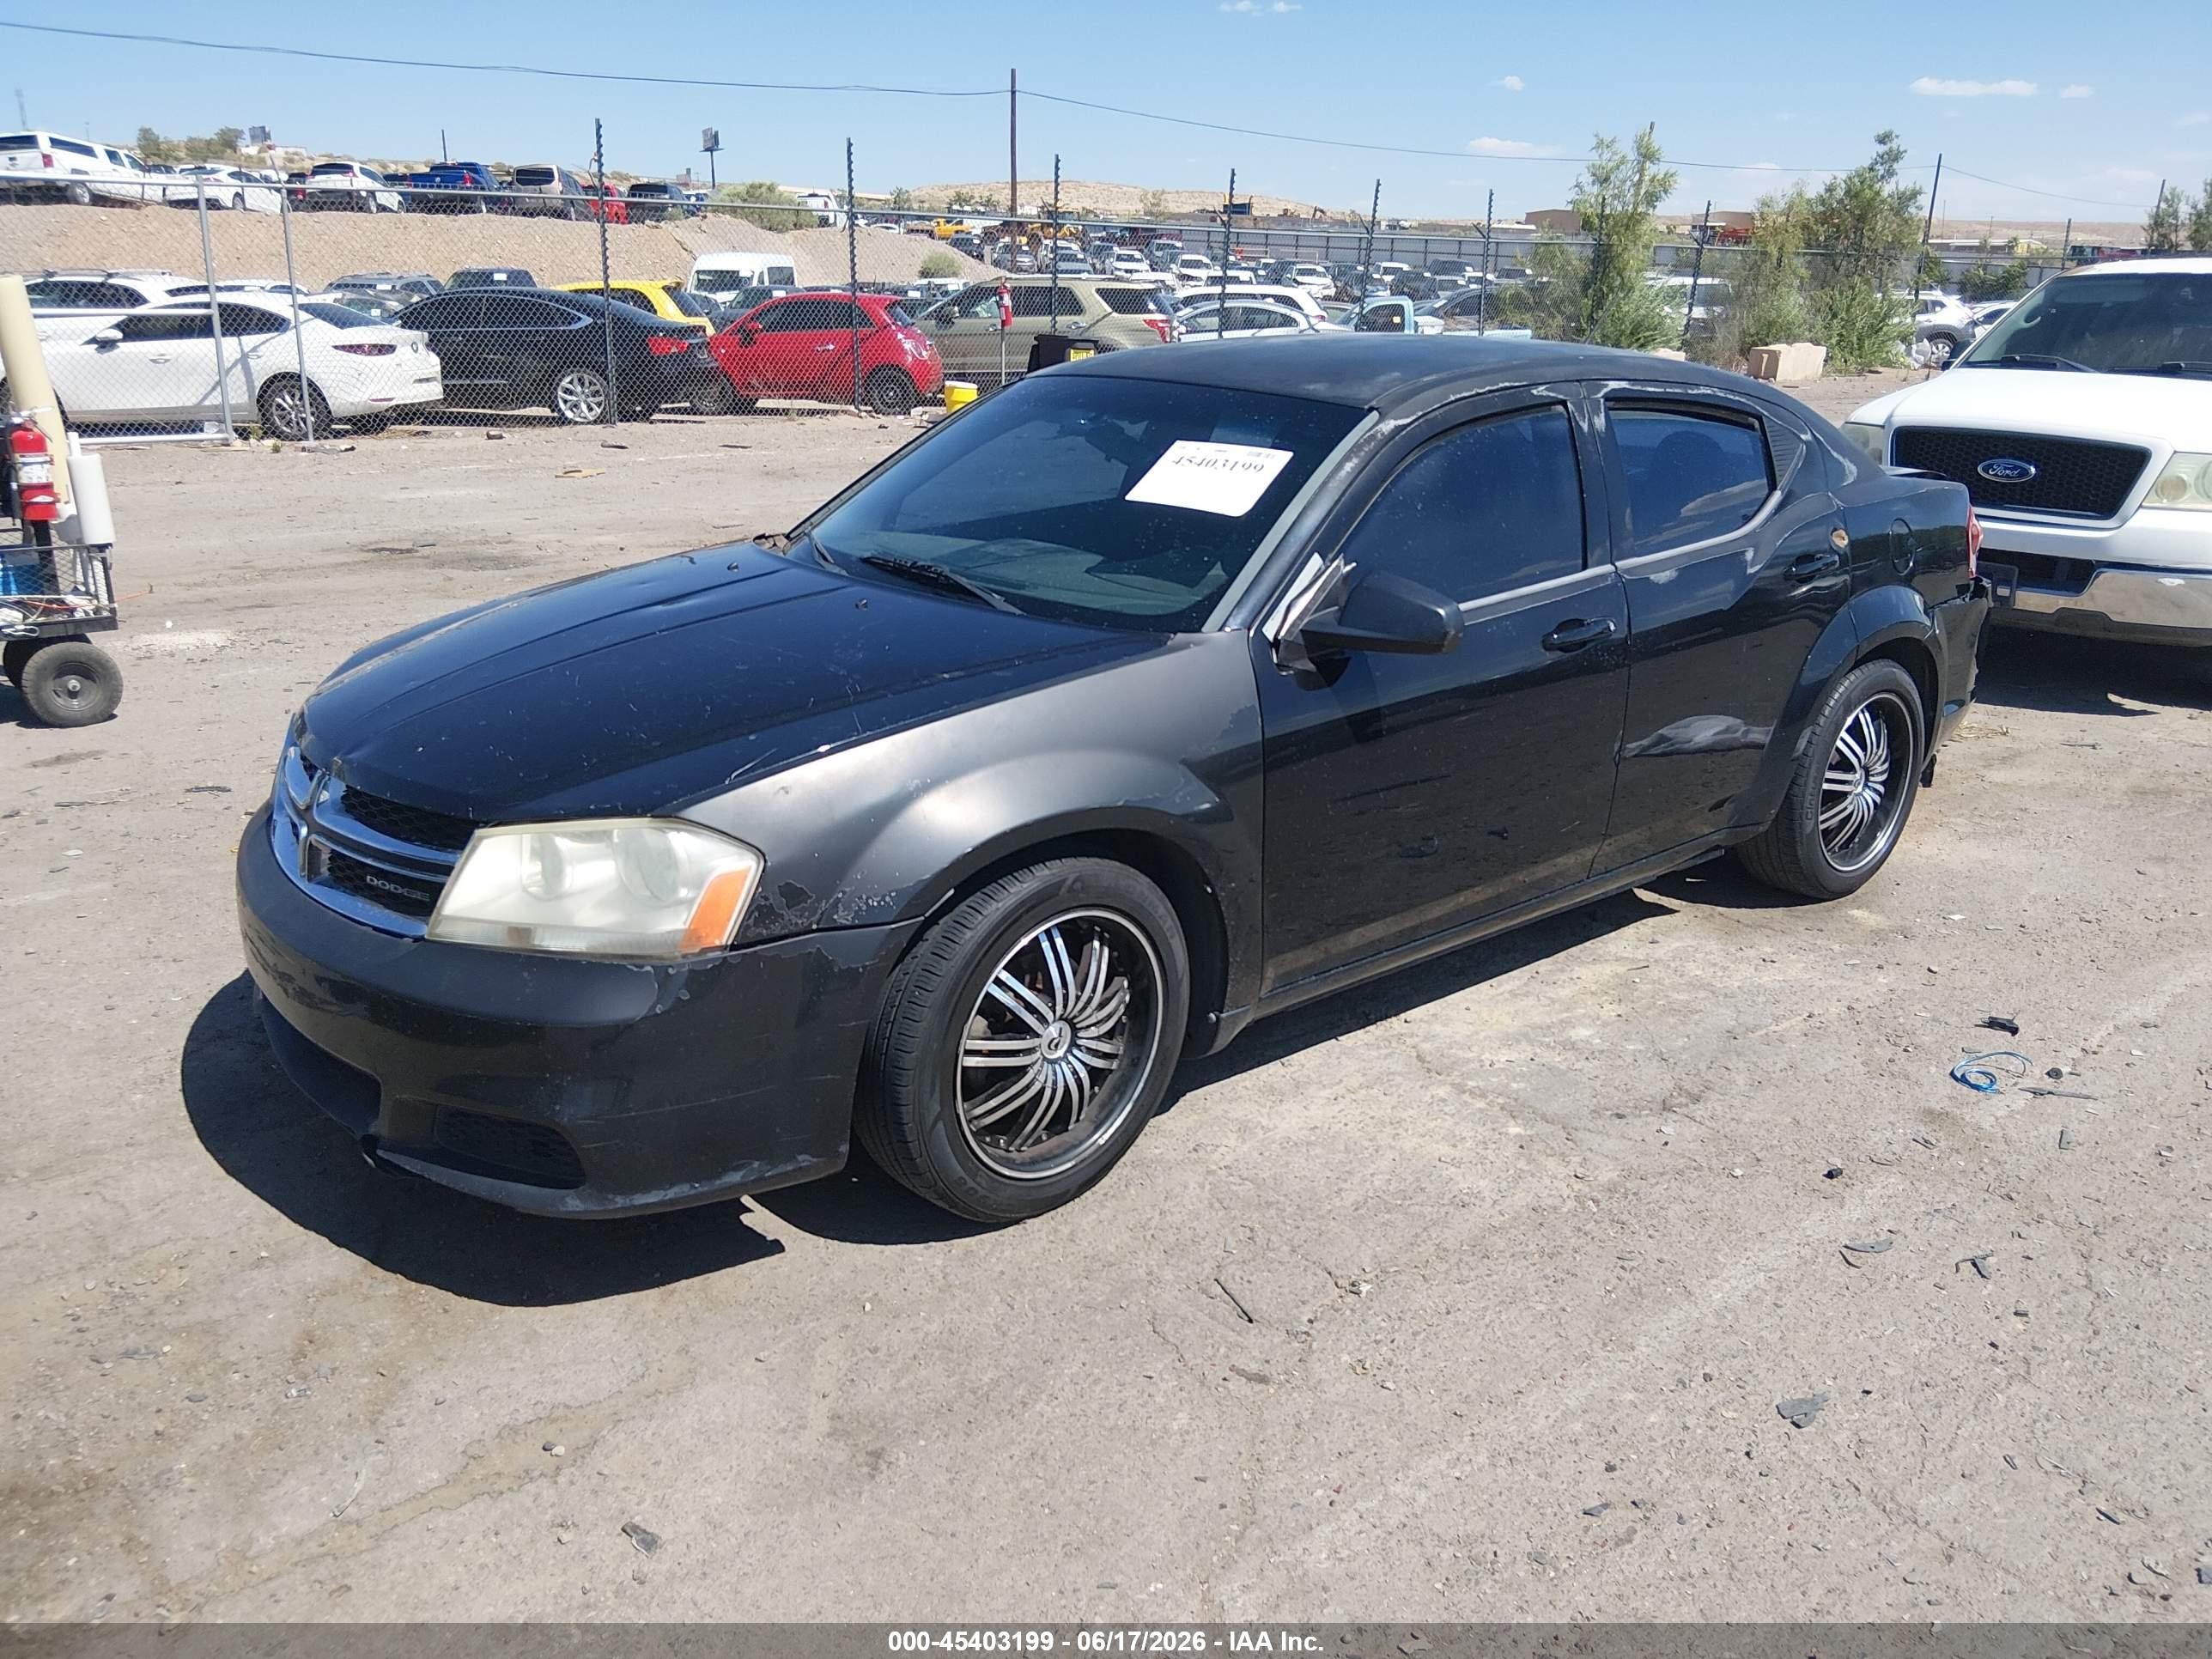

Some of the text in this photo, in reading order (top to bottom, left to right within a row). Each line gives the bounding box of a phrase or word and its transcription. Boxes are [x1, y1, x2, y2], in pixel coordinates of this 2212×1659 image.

[1171, 456, 1265, 472] 45403199
[1988, 463, 2021, 477] Ford
[366, 875, 430, 901] DODGE
